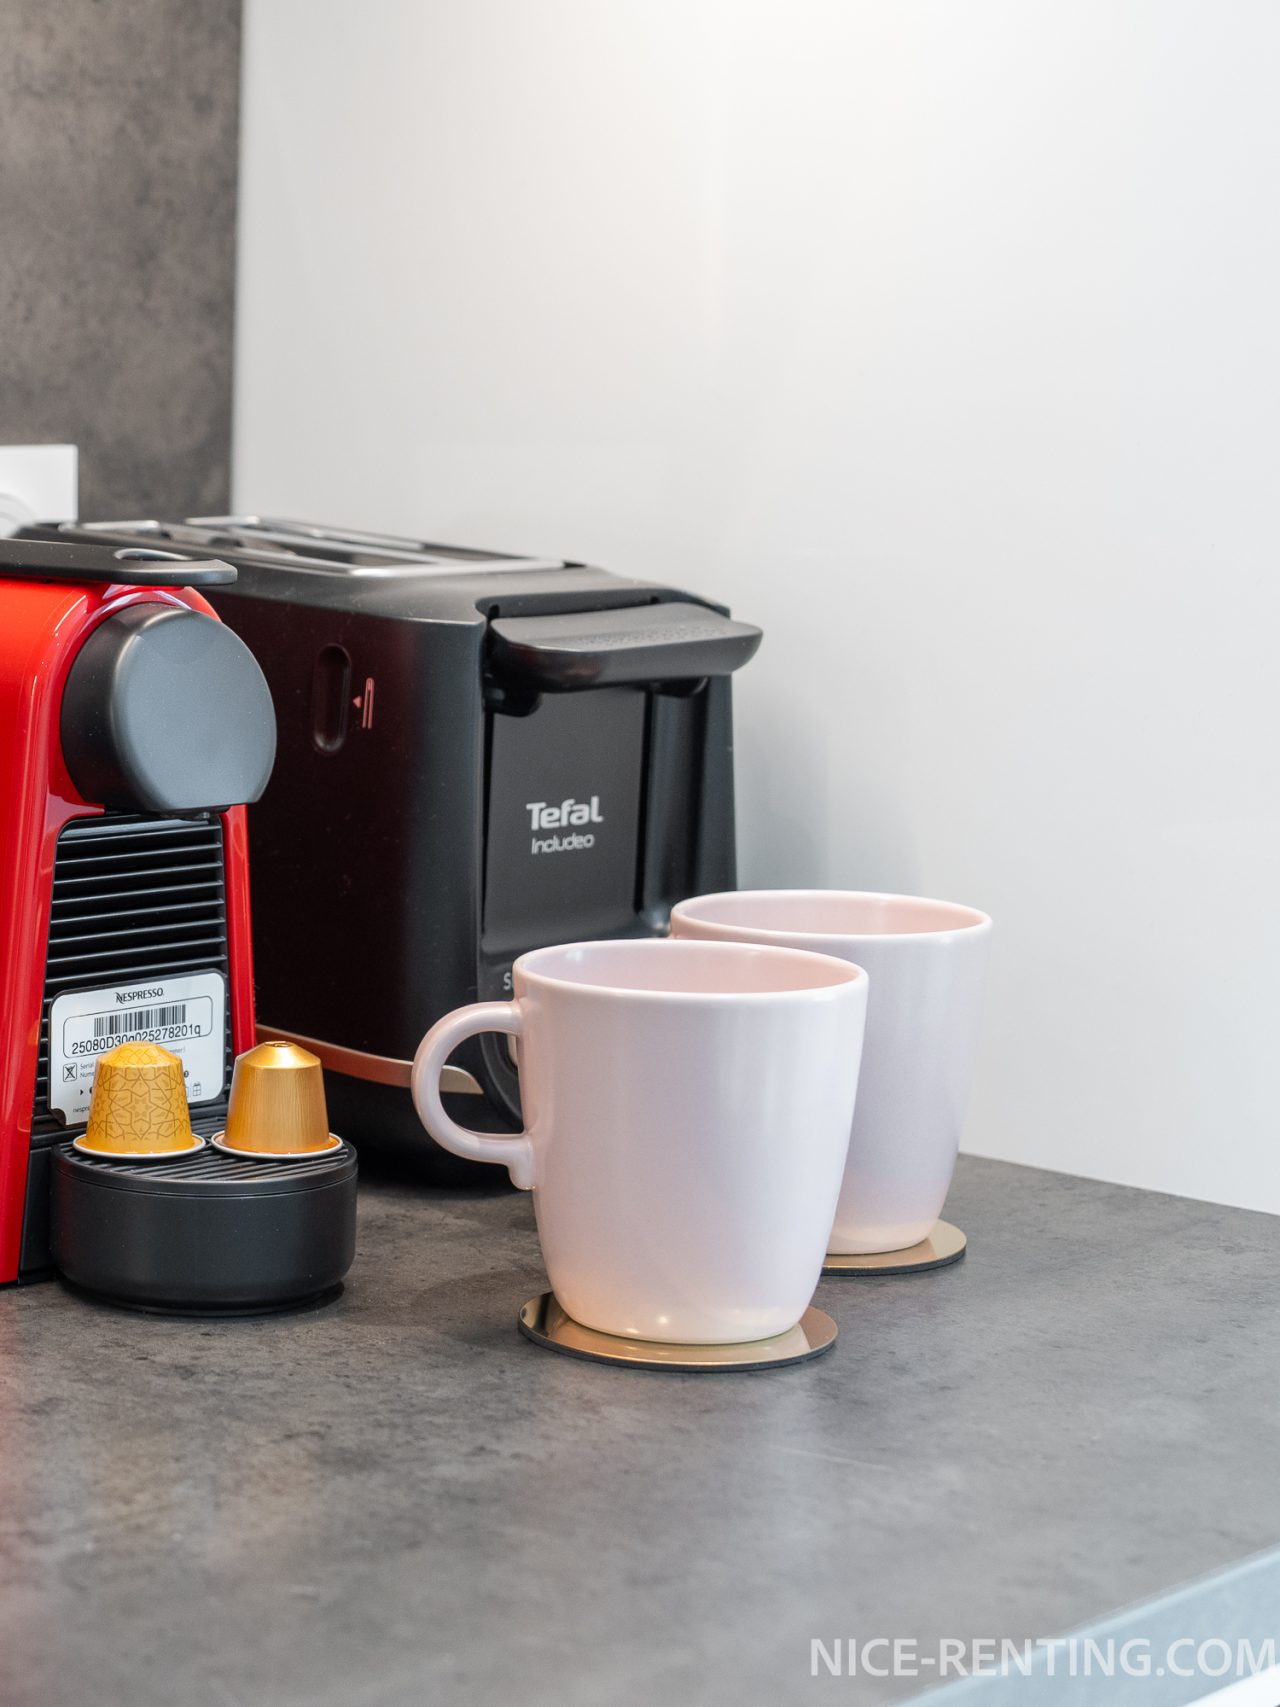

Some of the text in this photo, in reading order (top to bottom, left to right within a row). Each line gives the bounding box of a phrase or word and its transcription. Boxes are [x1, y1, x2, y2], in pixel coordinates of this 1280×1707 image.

[526, 796, 604, 831] Tefal
[531, 833, 595, 855] Includeo
[115, 987, 164, 1004] NESPRESSO
